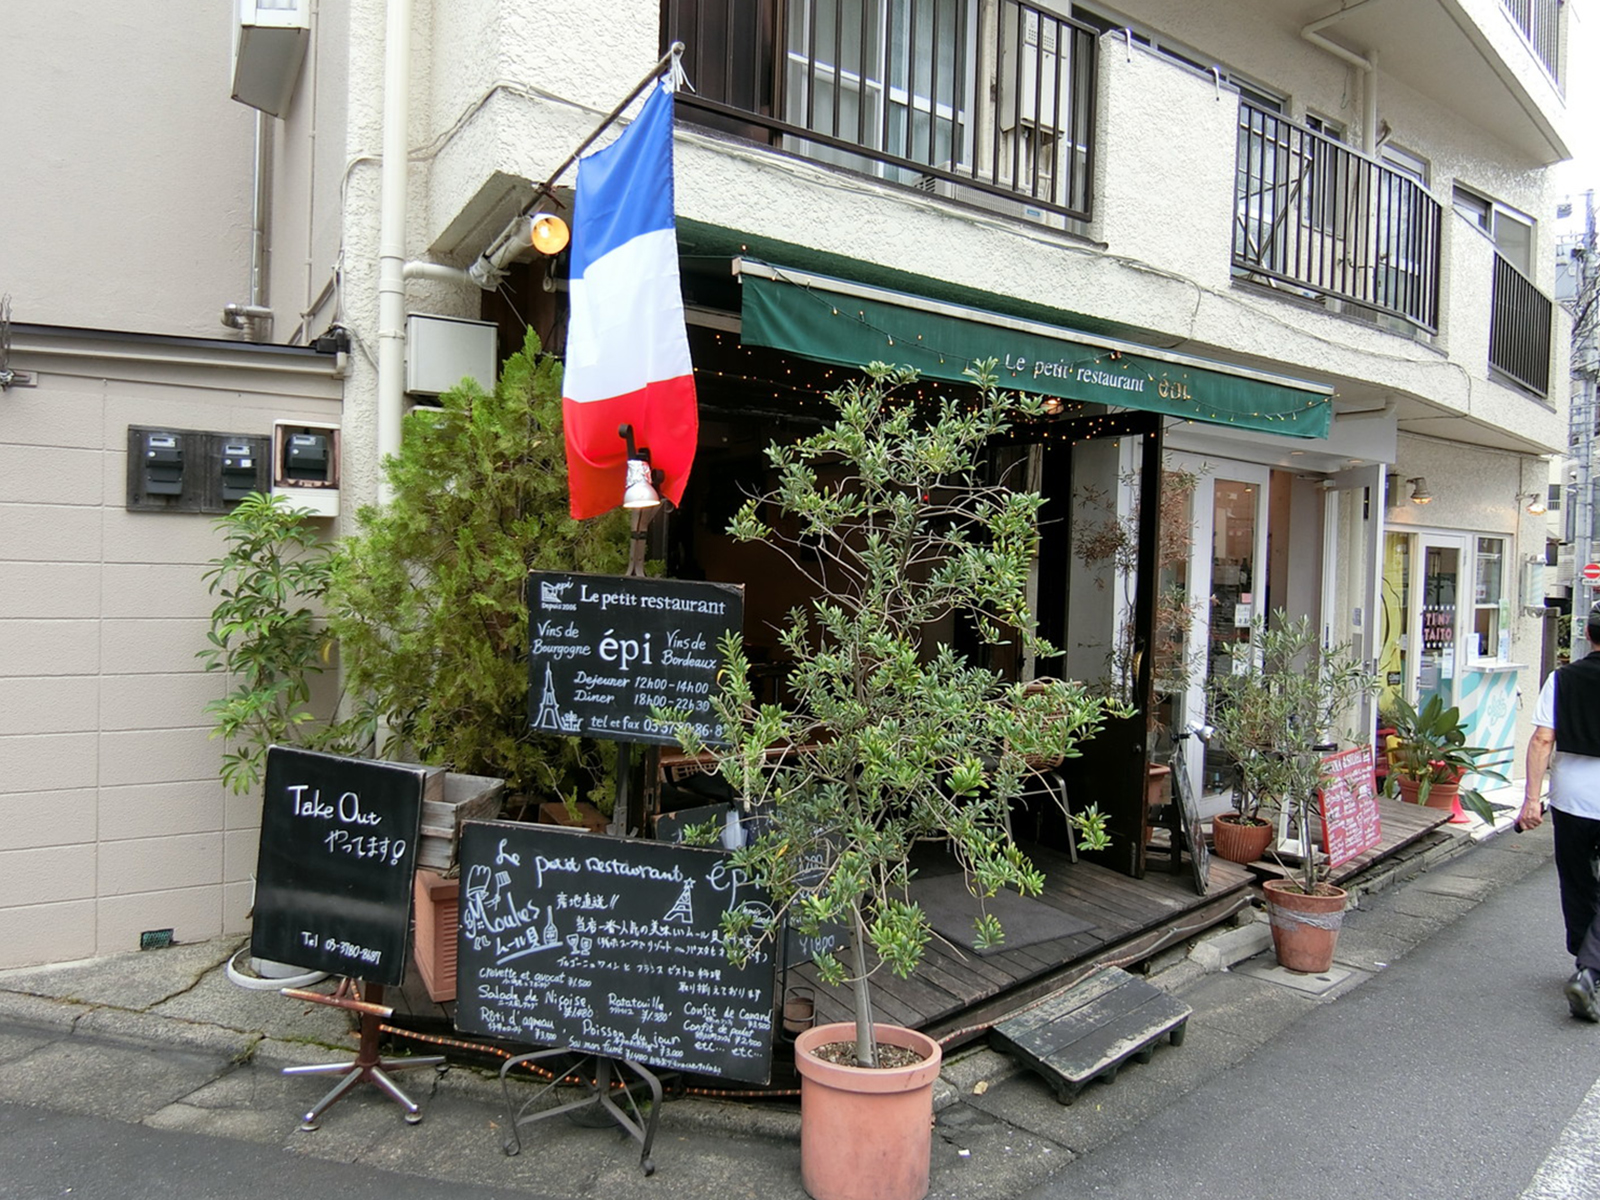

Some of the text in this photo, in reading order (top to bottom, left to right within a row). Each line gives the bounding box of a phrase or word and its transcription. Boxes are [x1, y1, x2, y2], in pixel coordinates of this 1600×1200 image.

[1004, 353, 1026, 372] Le
[1033, 358, 1069, 379] petit
[1076, 366, 1145, 393] restaurant
[580, 584, 726, 616] Le petit restaurant
[537, 619, 580, 638] Vins de
[1425, 612, 1451, 626] TINY
[666, 628, 707, 650] Vins de
[1424, 627, 1453, 641] TAITO
[532, 638, 592, 660] Bourgogne
[599, 628, 653, 671] épi
[660, 649, 717, 670] Bordeaux
[573, 670, 630, 690] Dejeuner
[573, 689, 616, 705] Diner
[590, 715, 609, 729] tel
[610, 718, 621, 728] et
[622, 715, 641, 730] fax
[287, 785, 383, 826] Take Out
[496, 838, 521, 866] Le
[584, 856, 685, 883] restaurant
[301, 931, 319, 949] Tel
[496, 926, 541, 956] ムール貝
[520, 970, 531, 980] et
[534, 971, 565, 984] avocat
[478, 984, 519, 1000] Salade
[525, 988, 539, 1002] de
[683, 1001, 773, 1024] Confit de Canard
[582, 1018, 626, 1040] Poisson
[631, 1027, 646, 1042] du
[652, 1031, 681, 1049] jour
[683, 1020, 714, 1034] Confit
[717, 1024, 728, 1035] de
